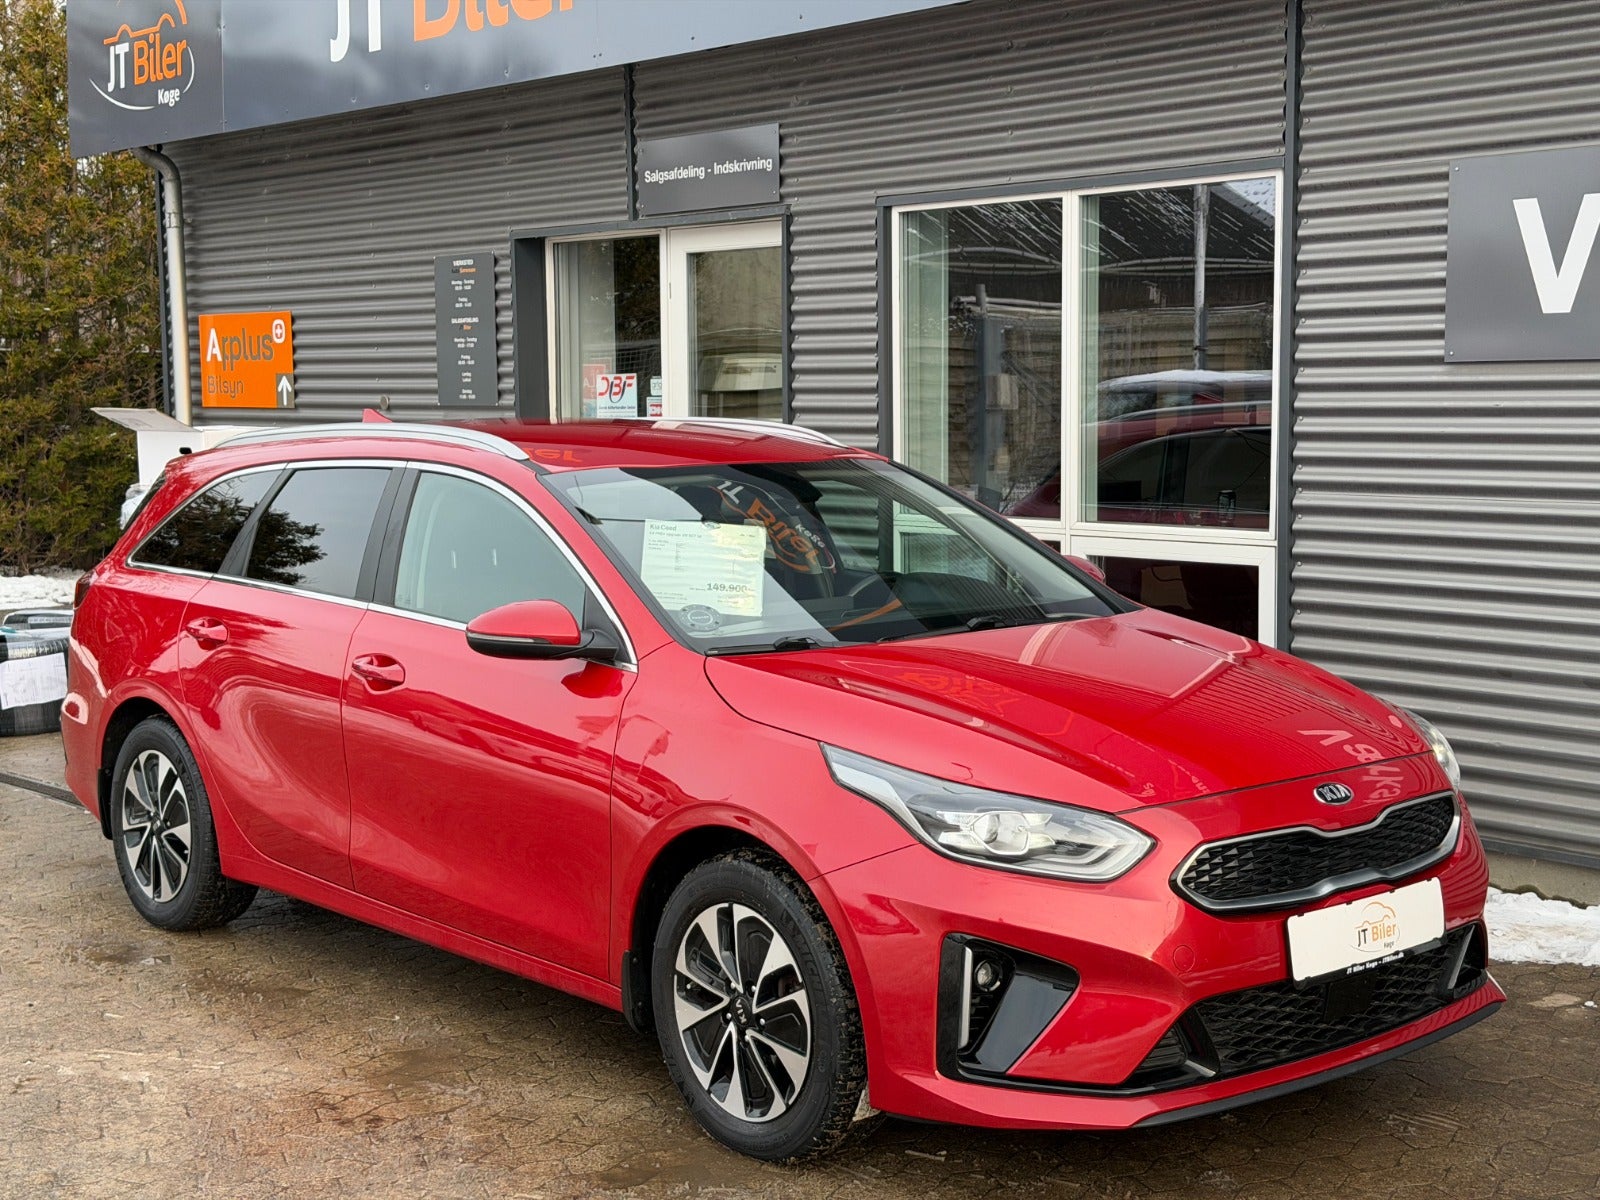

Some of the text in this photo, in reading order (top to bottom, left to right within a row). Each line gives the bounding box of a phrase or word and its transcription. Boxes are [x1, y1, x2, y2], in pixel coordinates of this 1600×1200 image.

[107, 33, 187, 92] JT Biler
[158, 88, 180, 107] Køge
[644, 165, 705, 184] Salgsafdeling
[713, 157, 773, 175] Indskrivning
[207, 375, 244, 399] Bilsyn
[1357, 922, 1396, 947] JT Biler
